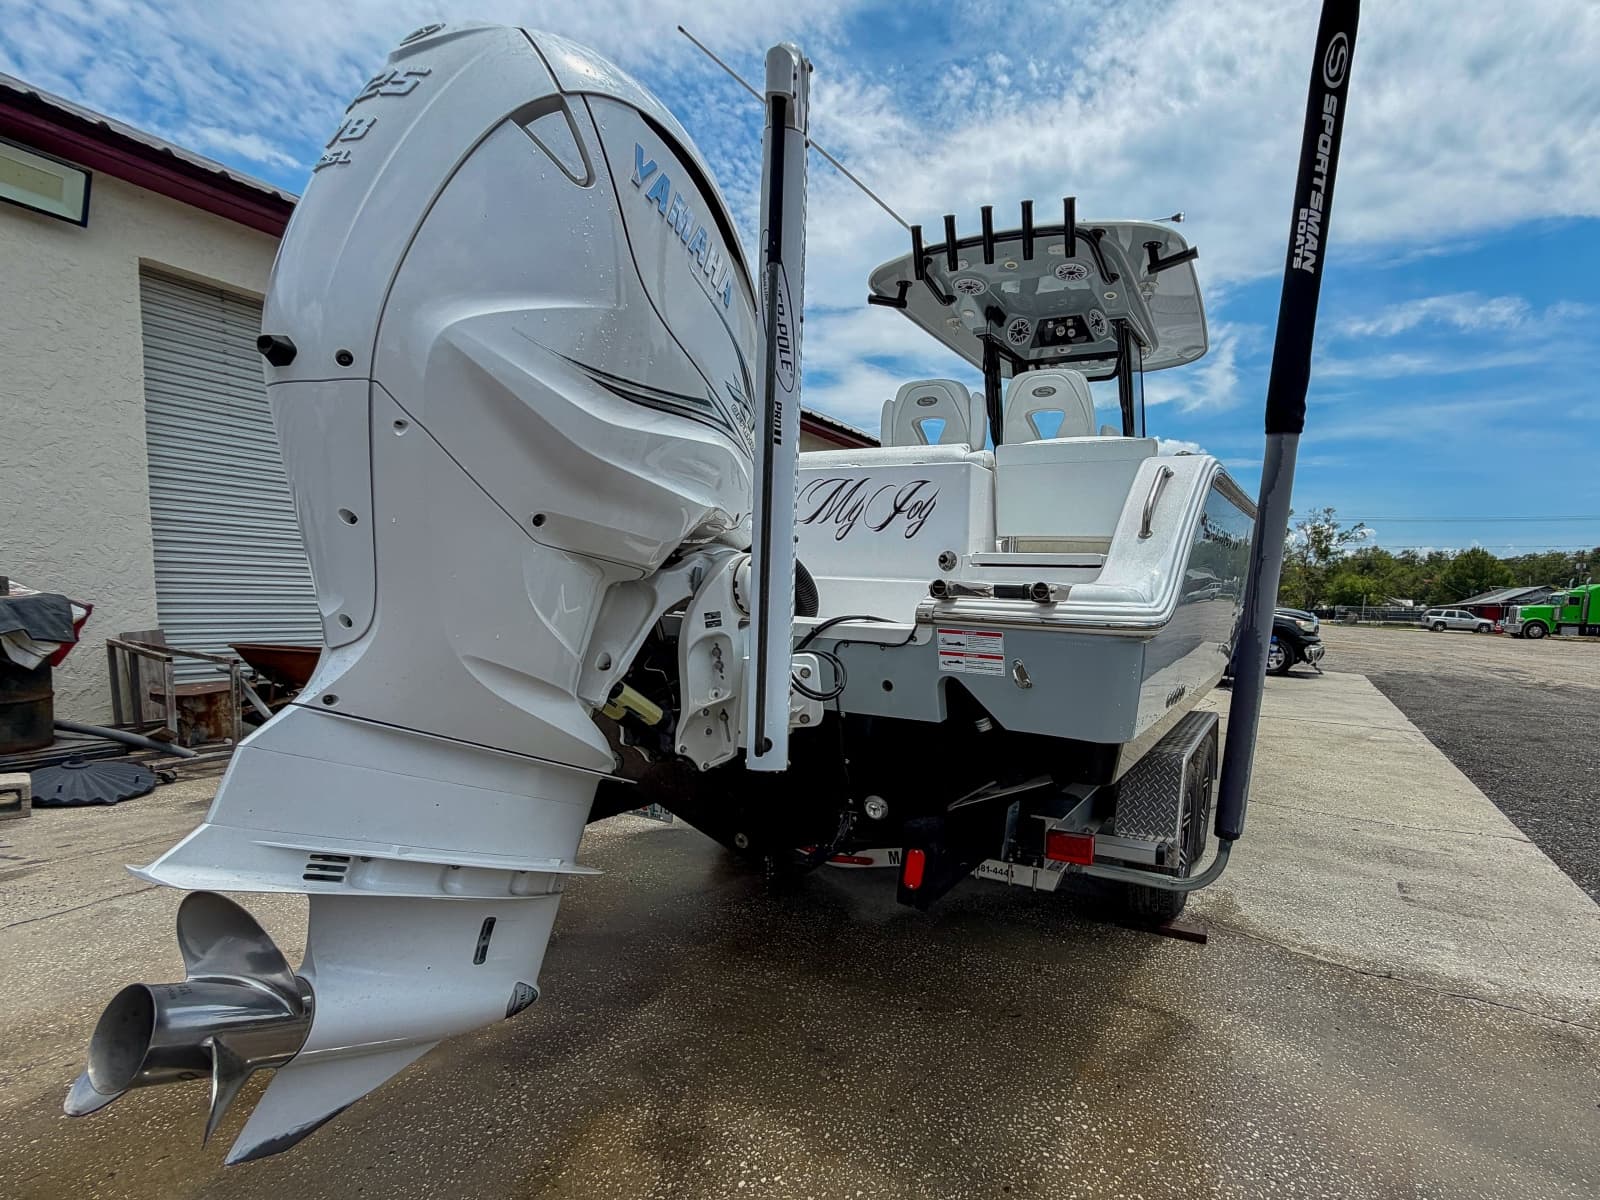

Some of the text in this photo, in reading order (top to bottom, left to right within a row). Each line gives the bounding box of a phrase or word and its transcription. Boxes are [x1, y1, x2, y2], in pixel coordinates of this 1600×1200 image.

[345, 68, 432, 114] 25
[1301, 93, 1338, 274] SPORTSMAN
[631, 142, 732, 309] YAMAHA
[1293, 208, 1309, 270] BOATS
[797, 477, 942, 541] My Joy
